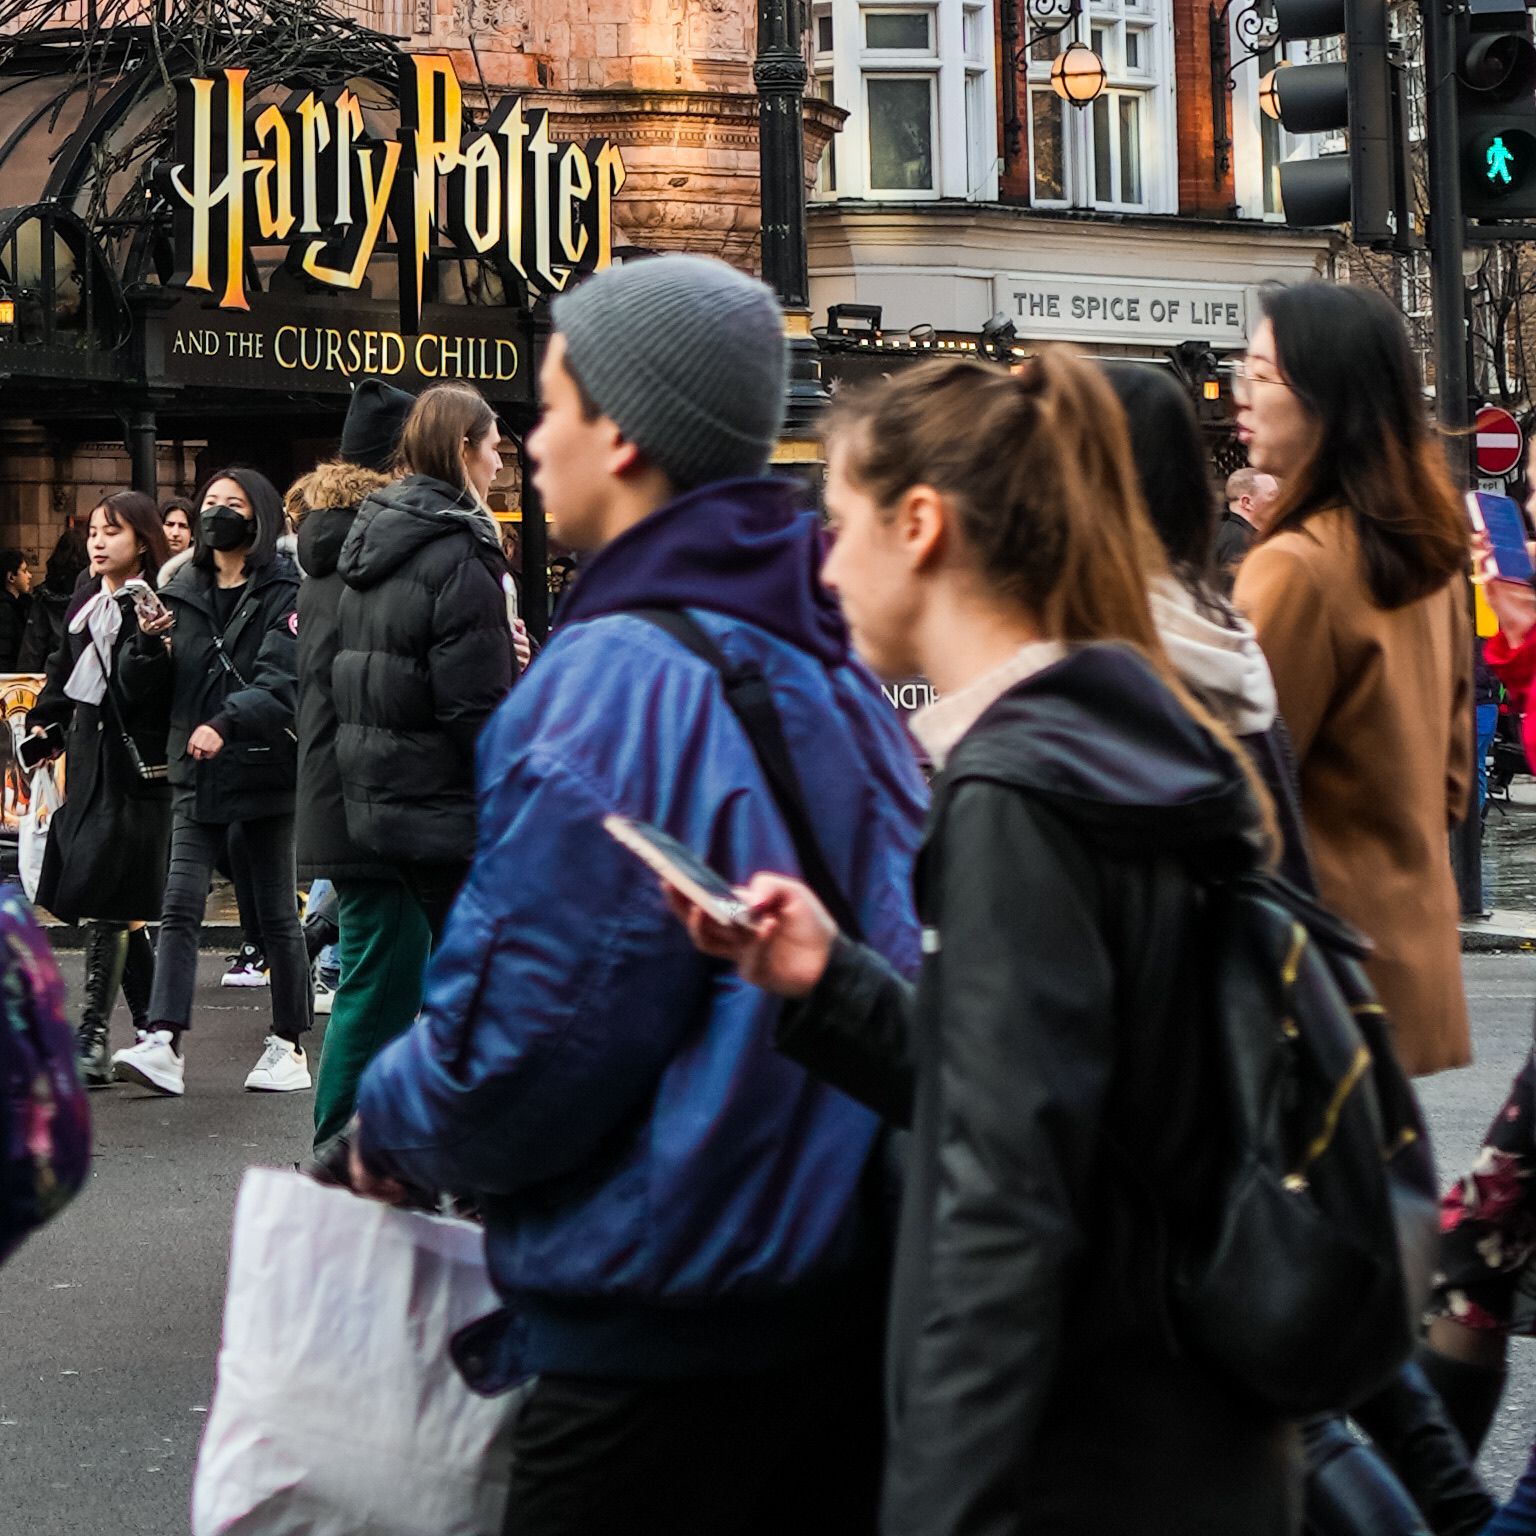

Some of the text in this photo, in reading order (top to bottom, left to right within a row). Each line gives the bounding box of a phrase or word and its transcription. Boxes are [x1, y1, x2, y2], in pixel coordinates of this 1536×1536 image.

[170, 54, 627, 326] Harry Potter
[1013, 292, 1240, 326] THE SPICE OF LIFE
[172, 325, 519, 381] AND THE CURSED CHILD
